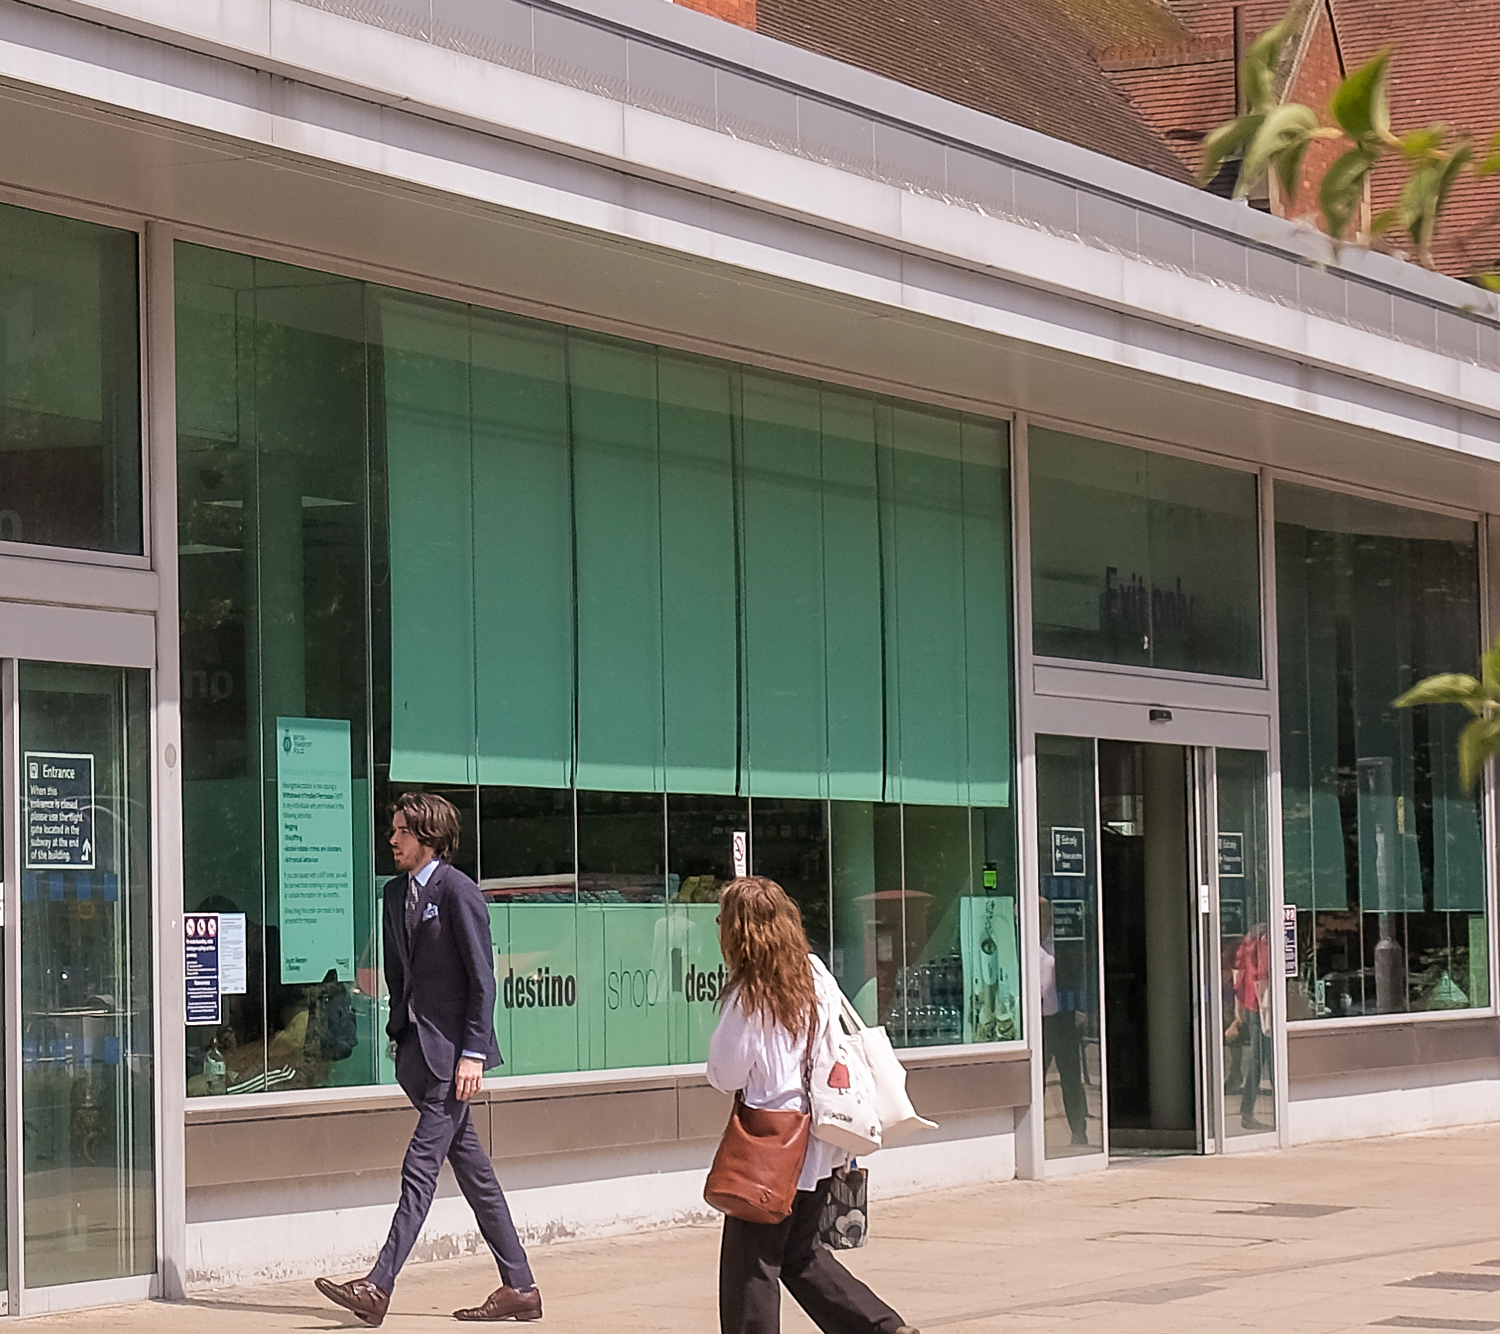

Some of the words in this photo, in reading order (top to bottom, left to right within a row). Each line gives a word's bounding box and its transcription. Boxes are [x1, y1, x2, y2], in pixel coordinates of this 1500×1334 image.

[42, 763, 76, 779] Entrance
[503, 967, 576, 1009] destino
[607, 959, 659, 1017] shop
